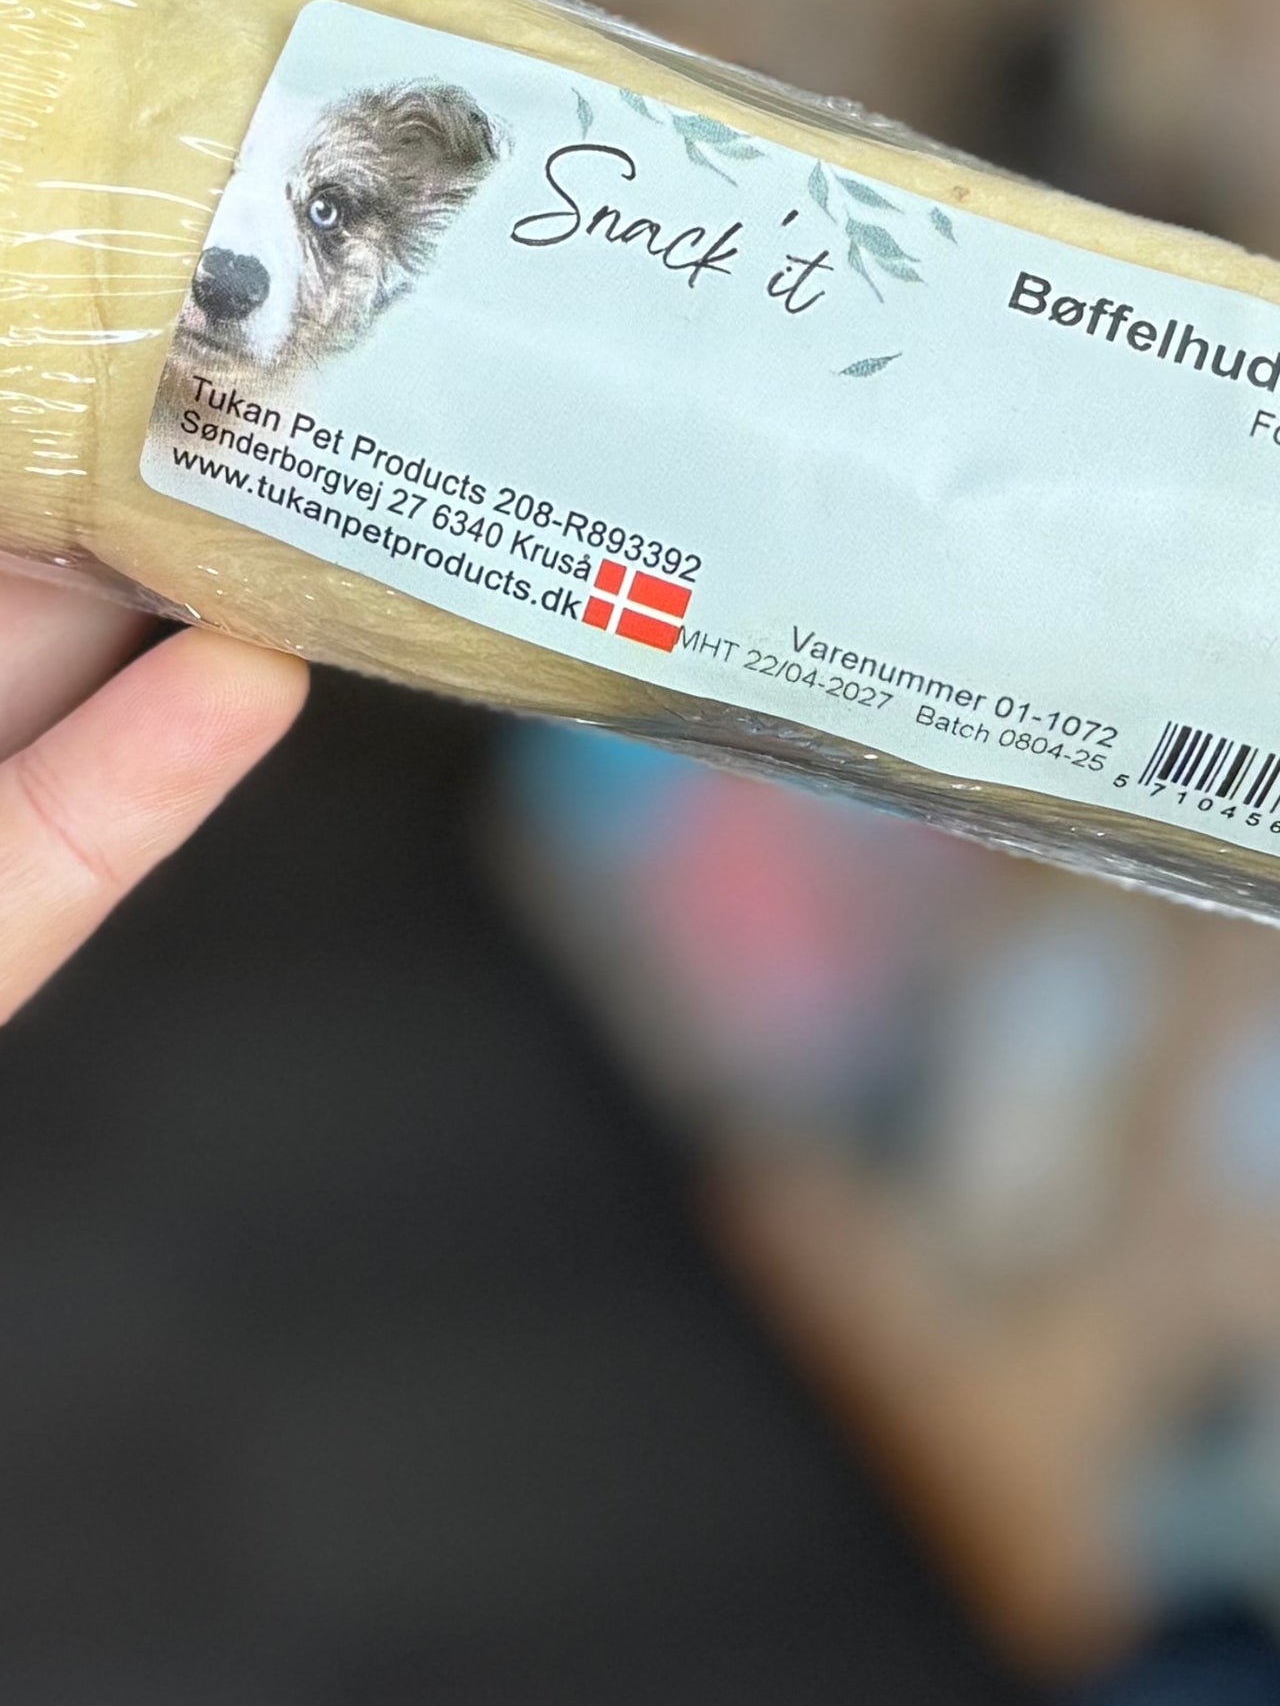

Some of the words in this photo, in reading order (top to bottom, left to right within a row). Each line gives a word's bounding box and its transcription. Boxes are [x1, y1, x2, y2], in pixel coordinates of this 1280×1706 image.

[510, 142, 745, 288] Snack
[172, 447, 582, 620] www.tukanpetproducts.dk
[180, 410, 384, 511] Sønderborgvej
[386, 488, 428, 520] 27
[432, 504, 504, 549] 6340
[509, 529, 593, 582] Kruså
[192, 374, 281, 432] Tukan
[289, 412, 344, 455] Pet
[351, 434, 487, 505] Products
[493, 487, 702, 583] 208-R893392
[675, 625, 740, 663] MHT
[743, 649, 894, 710] 22/04-2027
[915, 704, 990, 744] Batch
[998, 728, 1108, 773] 0804-25
[792, 625, 988, 713] Varenummer
[993, 696, 1120, 750] 01-1072
